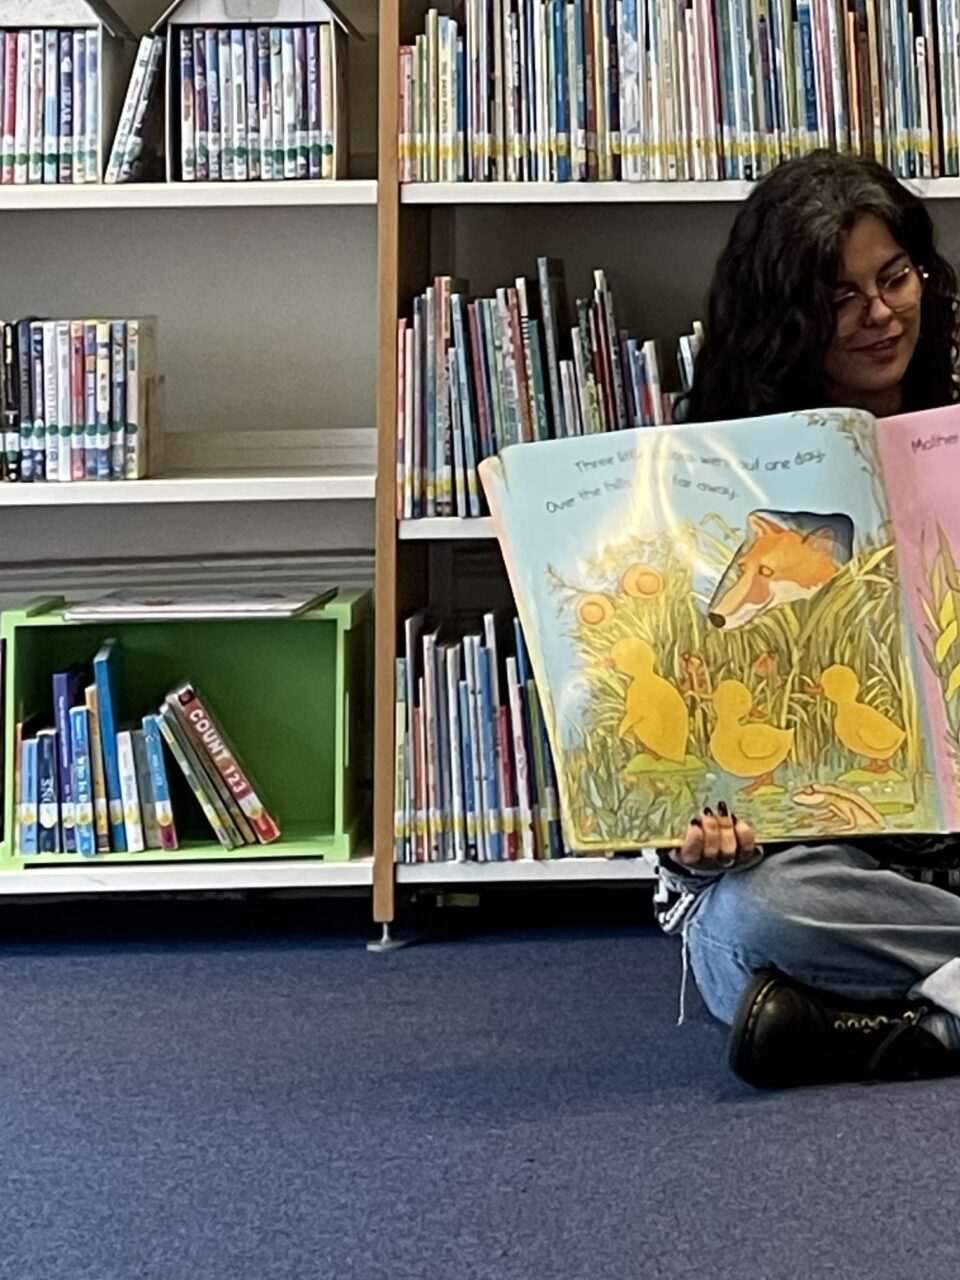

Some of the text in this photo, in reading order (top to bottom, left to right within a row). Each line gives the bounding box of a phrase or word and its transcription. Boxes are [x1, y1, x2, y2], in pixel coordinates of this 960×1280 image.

[911, 433, 959, 454] Mother
[574, 455, 614, 473] Three
[764, 458, 791, 472] one
[545, 496, 576, 515] Over
[576, 486, 601, 501] the
[188, 707, 250, 795] COUNT 123
